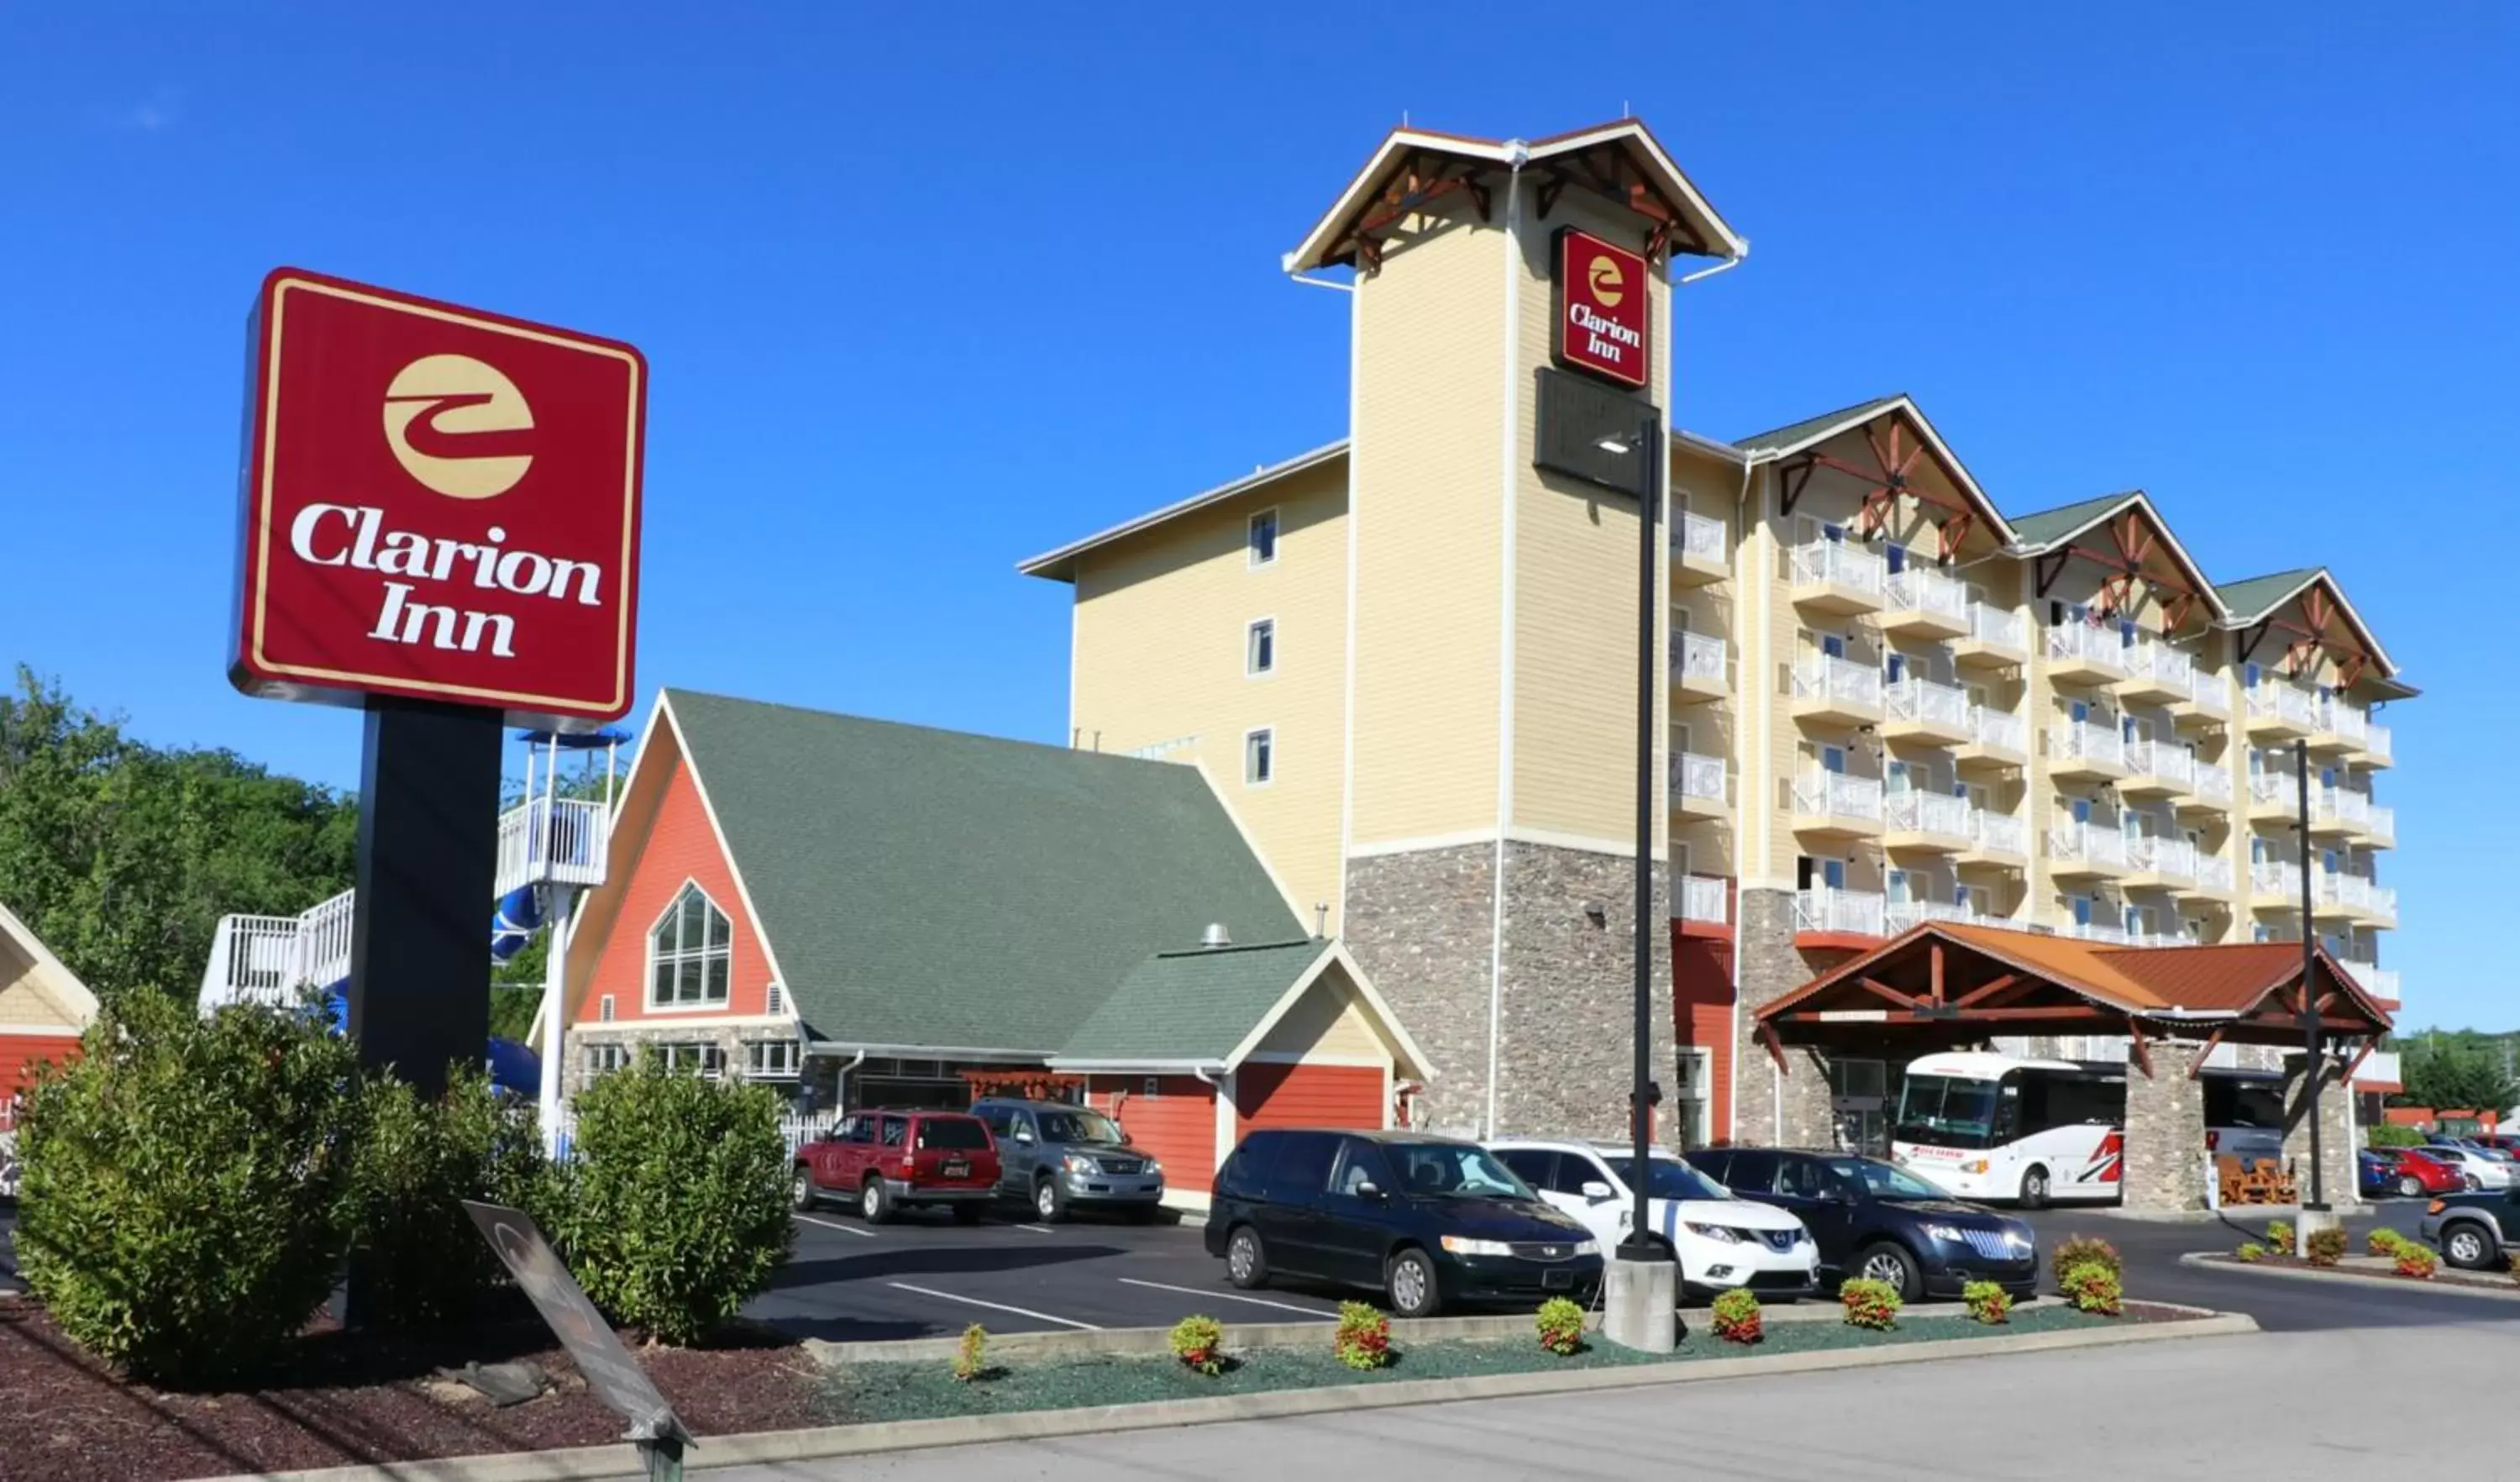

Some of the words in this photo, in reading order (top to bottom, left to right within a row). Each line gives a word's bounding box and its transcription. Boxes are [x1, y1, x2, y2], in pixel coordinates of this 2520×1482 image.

[1569, 302, 1640, 348] Clarion
[1587, 332, 1620, 363] Inn
[291, 502, 601, 606] Clarion
[367, 581, 516, 658] Inn
